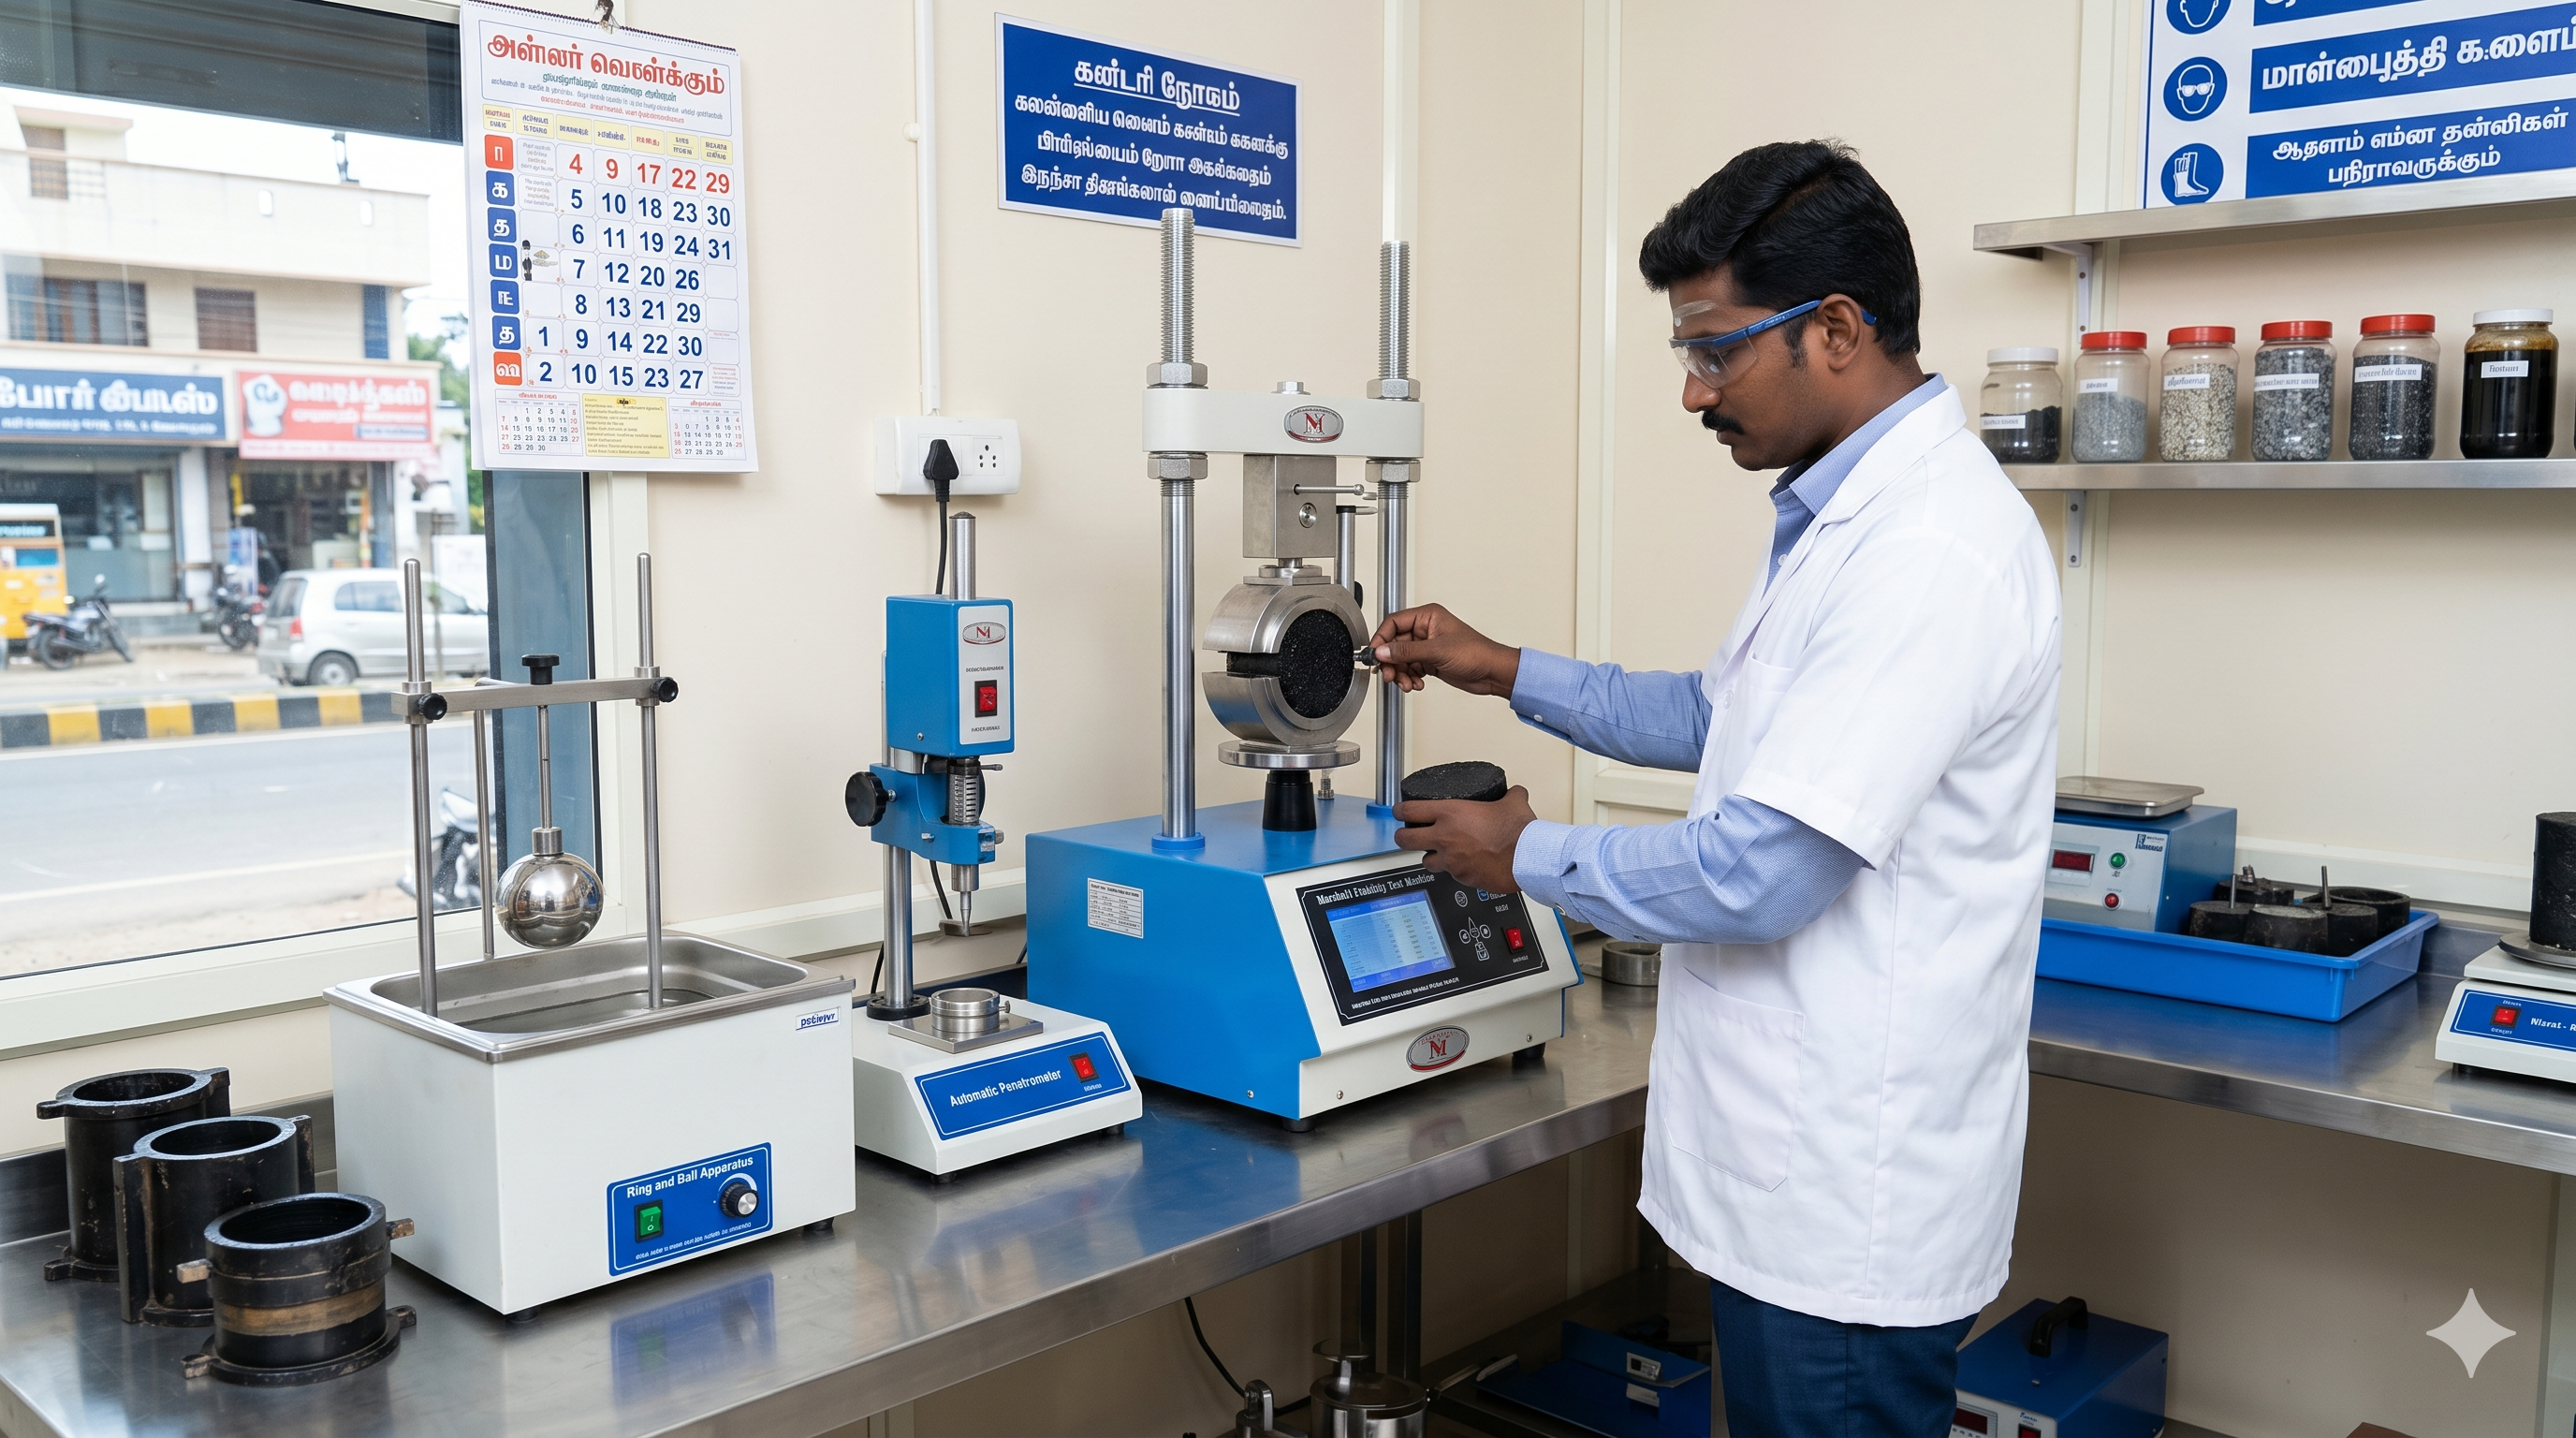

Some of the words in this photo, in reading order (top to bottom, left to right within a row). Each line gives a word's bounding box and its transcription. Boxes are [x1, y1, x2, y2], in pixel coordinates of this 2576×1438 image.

[568, 154, 581, 174] 4
[605, 159, 618, 179] 9
[637, 164, 660, 183] 17
[671, 169, 695, 190] 22
[705, 172, 729, 194] 29
[570, 189, 582, 209] 5
[601, 194, 625, 214] 10
[638, 198, 661, 218] 18
[672, 202, 696, 223] 23
[707, 206, 730, 227] 30
[571, 225, 584, 244] 6
[603, 228, 623, 247] 11
[640, 233, 663, 253] 19
[674, 236, 698, 257] 24
[708, 240, 729, 259] 31
[573, 260, 584, 278] 7
[604, 263, 628, 284] 12
[639, 266, 665, 287] 20
[674, 270, 698, 291] 26
[575, 295, 586, 315] 8
[606, 298, 630, 318] 13
[641, 301, 663, 319] 21
[676, 303, 700, 323] 29
[538, 328, 547, 346] 1
[575, 330, 588, 349] 9
[607, 332, 632, 351] 14
[642, 334, 666, 355] 22
[678, 337, 702, 357] 30
[539, 362, 551, 382] 2
[571, 364, 595, 385] 10
[609, 367, 633, 387] 15
[644, 369, 668, 389] 23
[680, 371, 702, 389] 27
[1387, 880, 1404, 890] Test
[949, 1086, 999, 1108] Automatic
[626, 1183, 652, 1198] Ring
[655, 1176, 675, 1191] and
[677, 1169, 697, 1184] Ball
[700, 1156, 754, 1181] Apparatus
